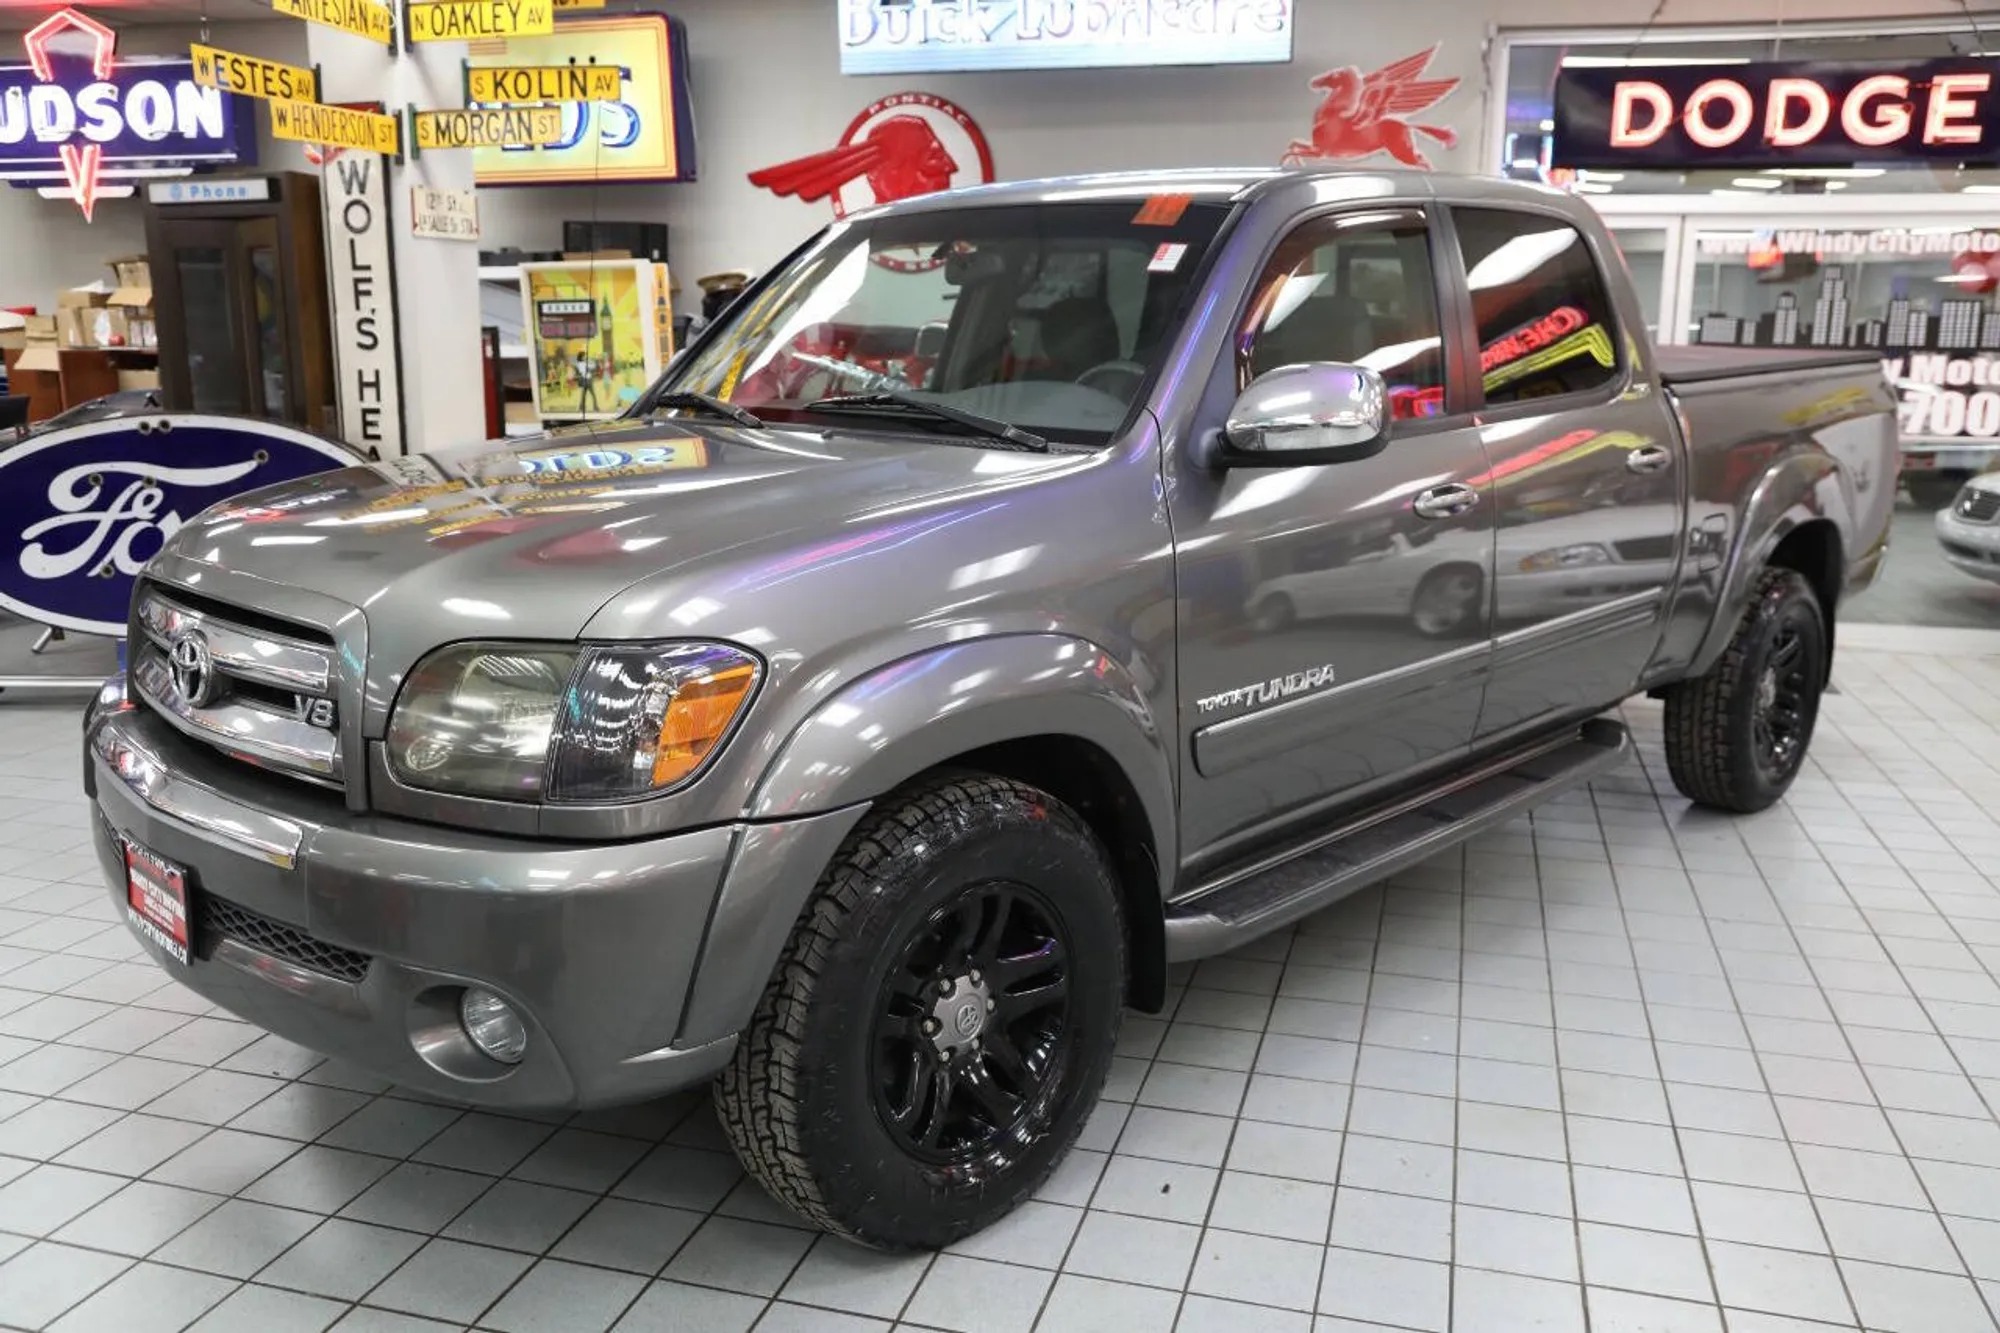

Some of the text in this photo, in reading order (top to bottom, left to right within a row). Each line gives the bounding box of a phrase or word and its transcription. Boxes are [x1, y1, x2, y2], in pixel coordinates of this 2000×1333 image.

[415, 2, 546, 37] N OAKLEY AV
[197, 54, 310, 99] W ESTES AV
[474, 67, 614, 99] S KOLIN AV
[275, 106, 393, 147] W HENDERSON ST
[869, 93, 969, 126] PONTIAC
[1610, 73, 1991, 148] DODGE
[420, 112, 556, 145] S MORGAN ST
[1197, 664, 1335, 713] TOYOTA TUNDRA
[294, 694, 333, 727] V8
